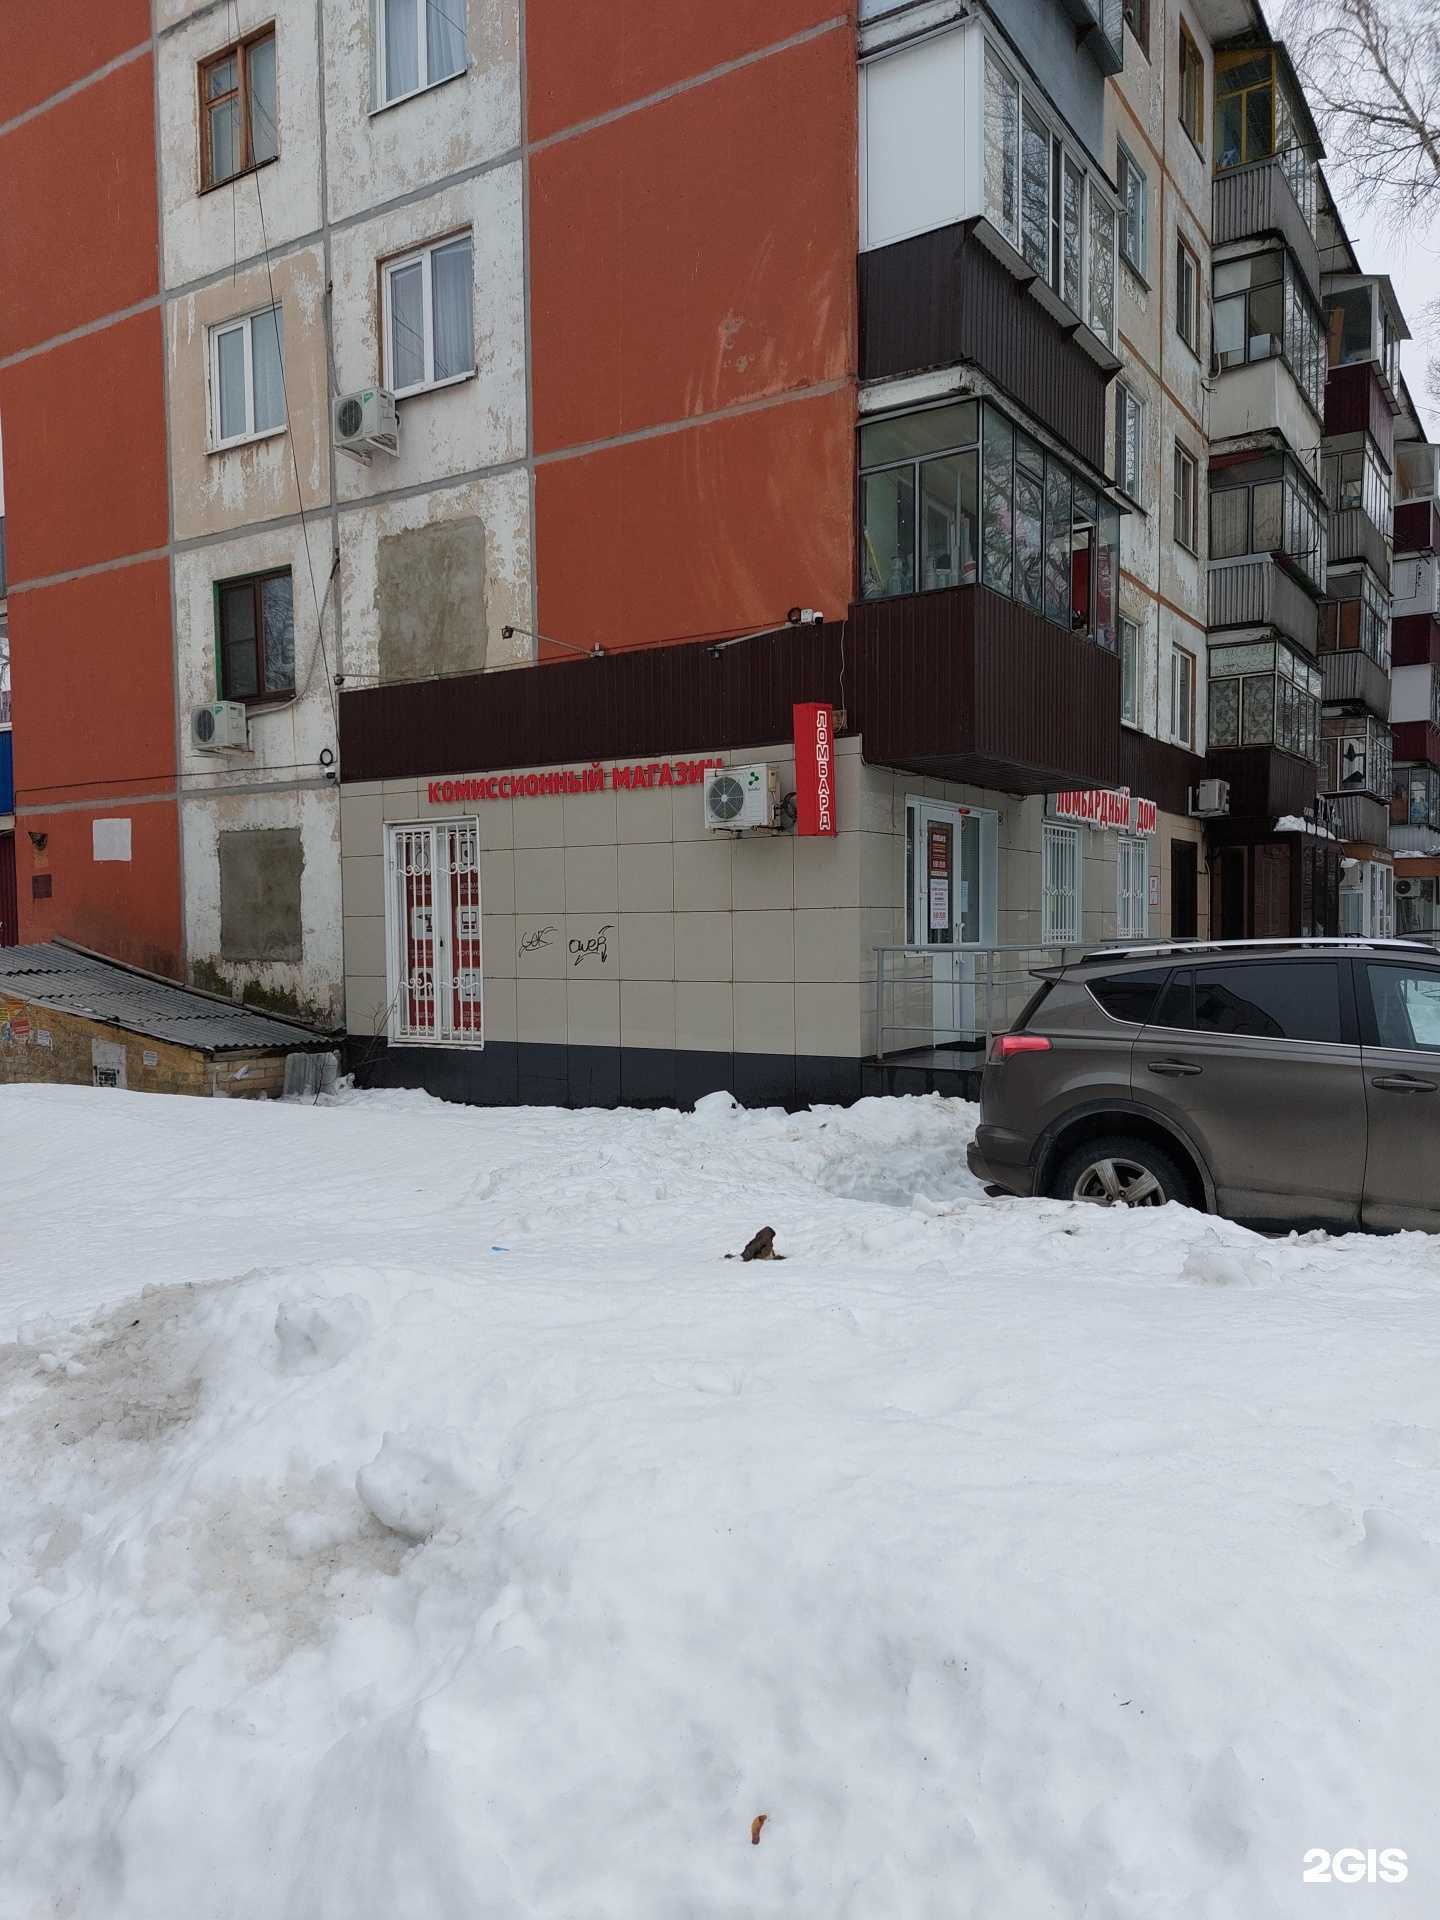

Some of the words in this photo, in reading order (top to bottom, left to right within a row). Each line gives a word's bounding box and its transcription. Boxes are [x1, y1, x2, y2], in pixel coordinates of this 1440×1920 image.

[428, 762, 606, 804] КОМИССИОННЫЙ
[816, 710, 831, 831] ЛОМБАРД
[1136, 797, 1157, 837] ДОМ
